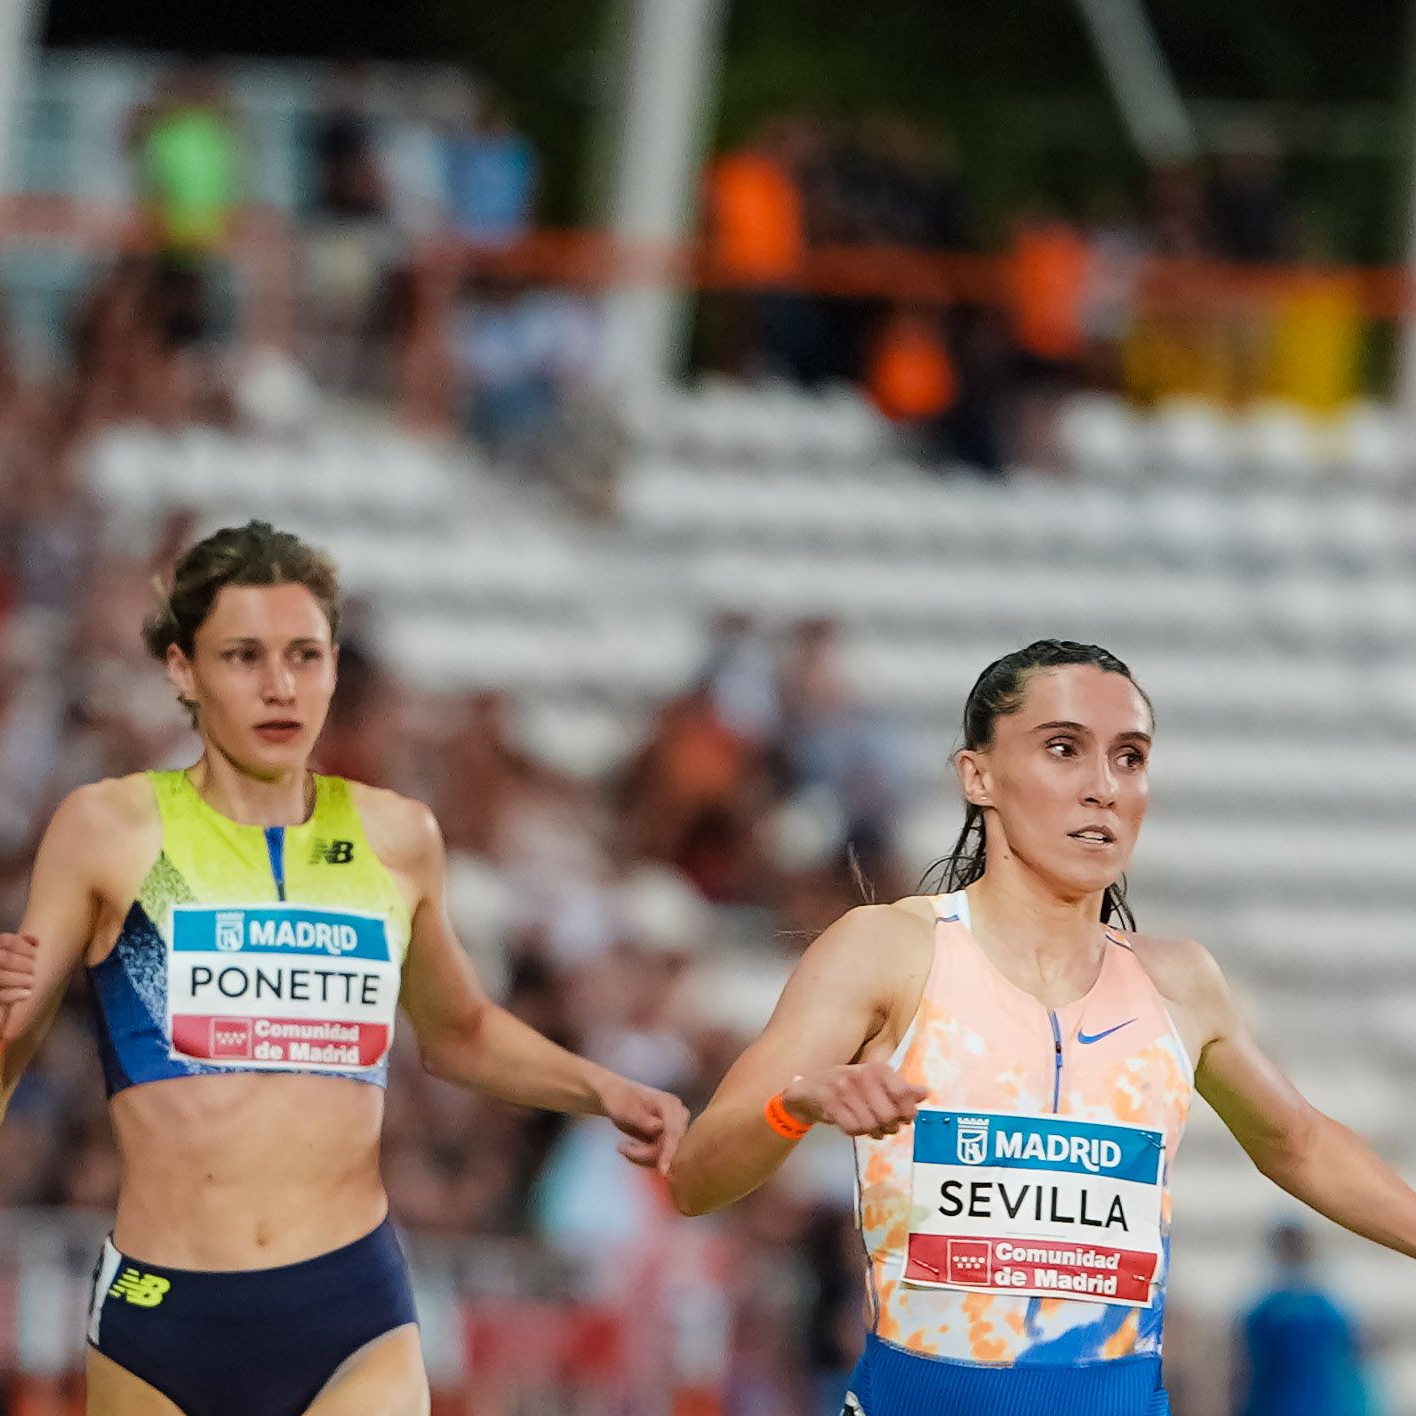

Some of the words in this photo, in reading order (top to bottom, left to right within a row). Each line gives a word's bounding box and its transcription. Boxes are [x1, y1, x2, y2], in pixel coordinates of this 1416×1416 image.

[249, 921, 358, 955] MADRID
[191, 966, 381, 1005] PONETTE
[254, 1019, 360, 1042] Comunidad
[254, 1041, 284, 1060] de
[289, 1043, 360, 1065] Madrid
[995, 1130, 1122, 1172] MADRID
[938, 1180, 1130, 1232] SEVILLA
[994, 1242, 1121, 1270] Comunidad
[993, 1268, 1028, 1287] de
[1034, 1269, 1118, 1296] Madrid
